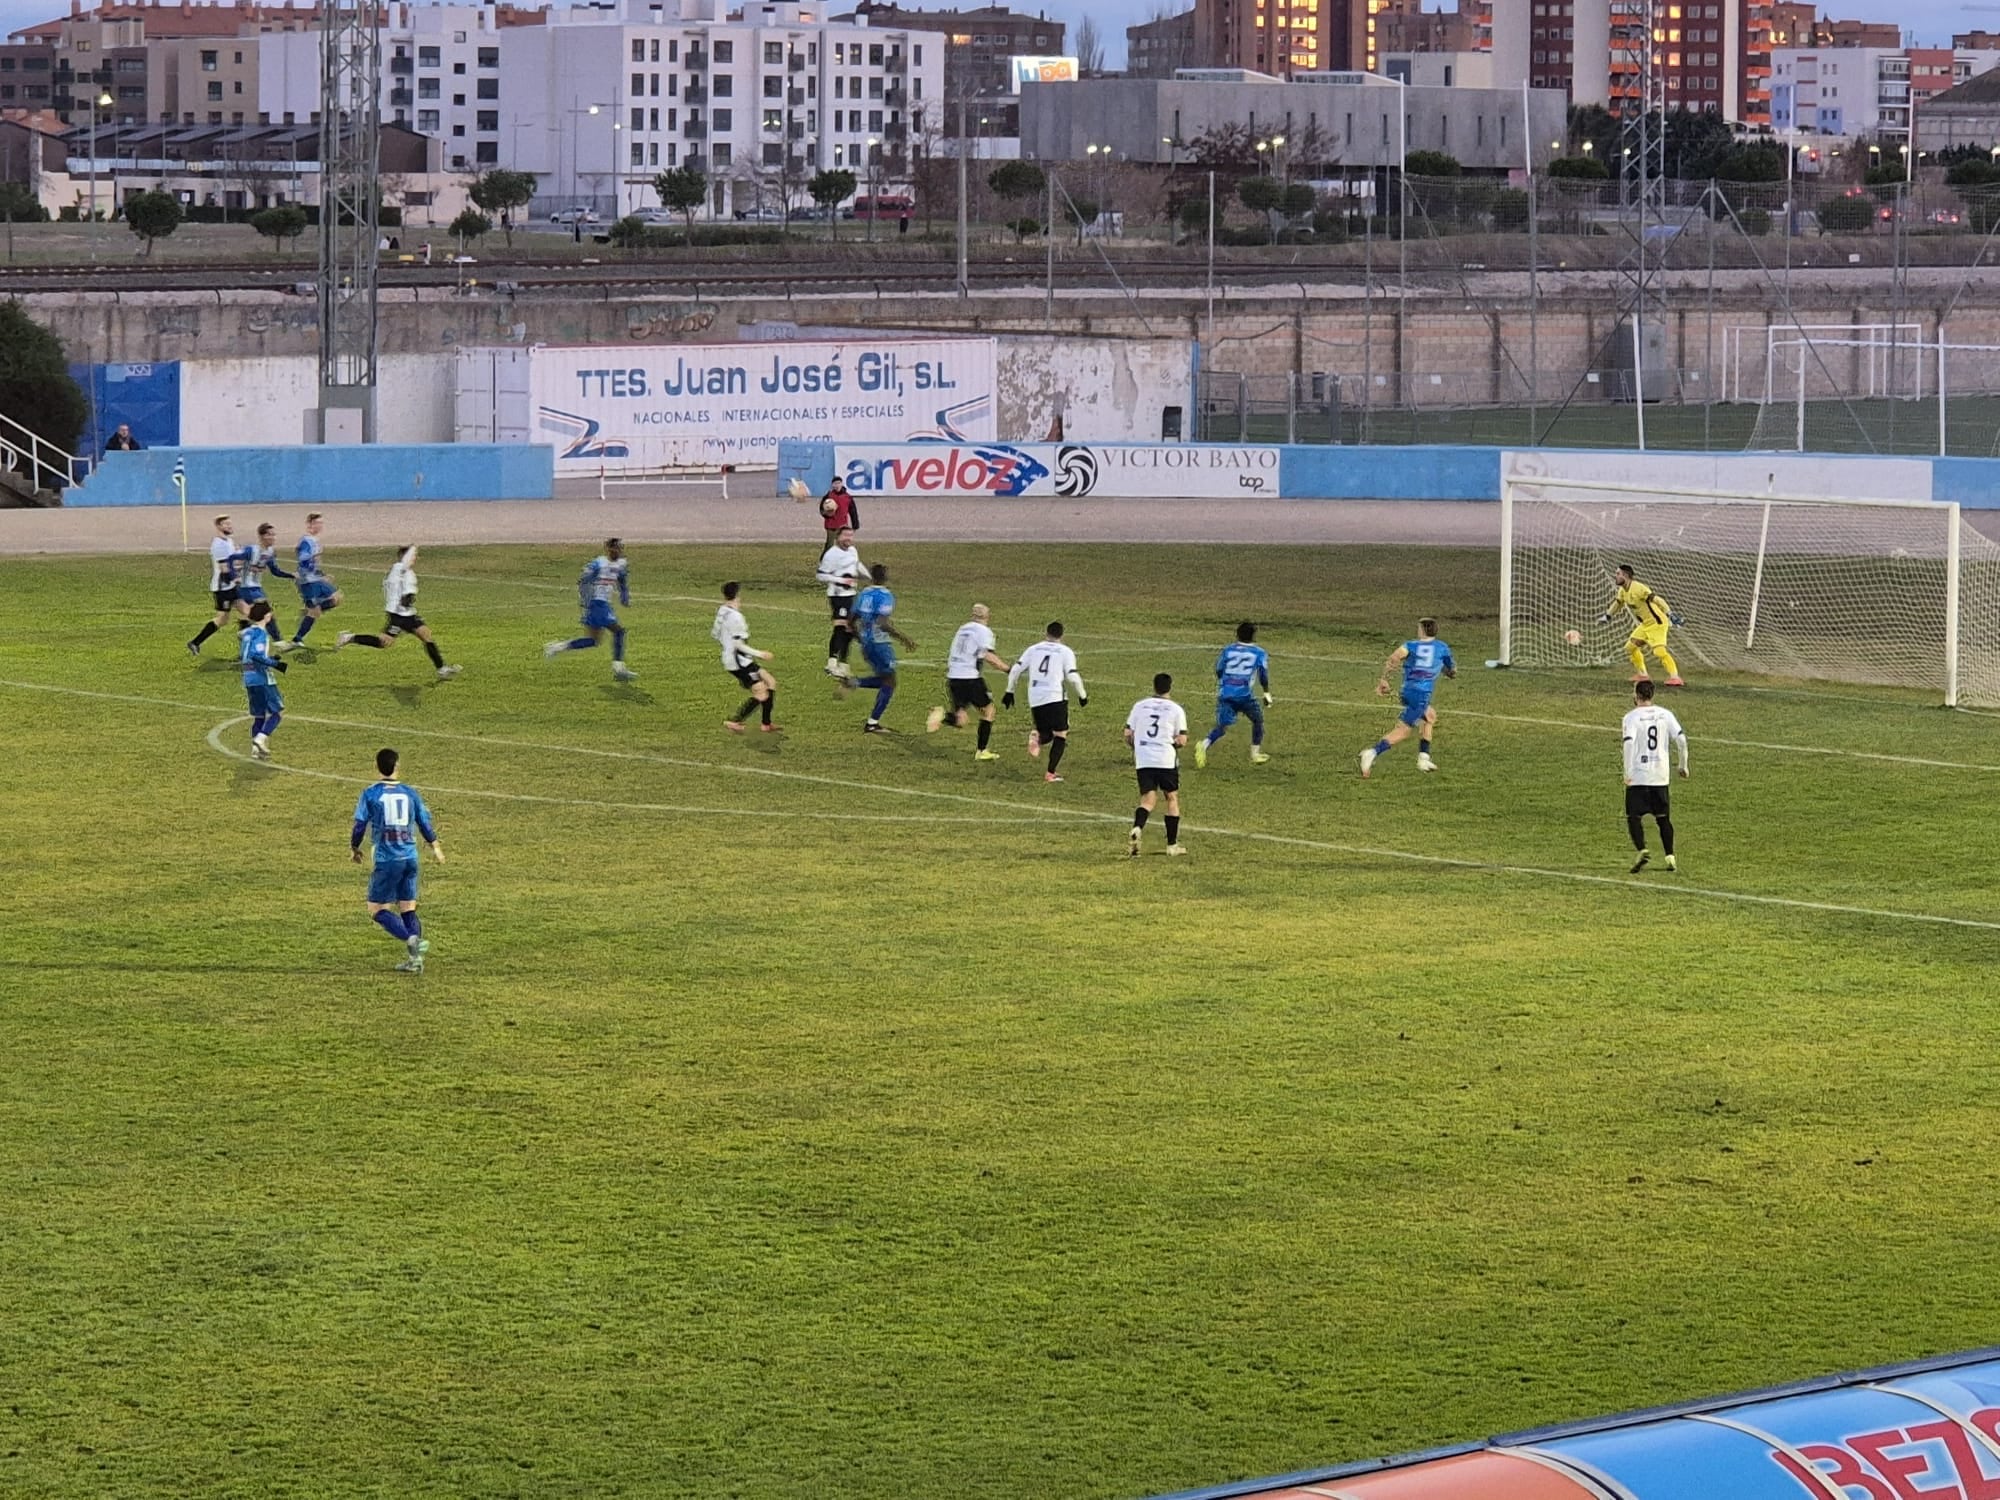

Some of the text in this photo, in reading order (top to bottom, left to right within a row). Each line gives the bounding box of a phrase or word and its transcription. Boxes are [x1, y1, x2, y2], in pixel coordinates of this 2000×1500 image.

[576, 368, 652, 398] TTES.
[664, 356, 747, 397] Juan
[761, 353, 842, 393] José
[857, 352, 904, 397] Gil,
[633, 404, 905, 425] NACIONALES INTERNACIONALES Y ESPECIALES
[846, 448, 1017, 492] arveloz
[1102, 449, 1278, 469] VICTOR BAYO
[1038, 654, 1052, 678] 4
[1225, 651, 1258, 675] 22
[1415, 644, 1435, 667] 9
[1146, 714, 1161, 738] 3
[1647, 725, 1658, 751] 8
[379, 793, 409, 826] 10
